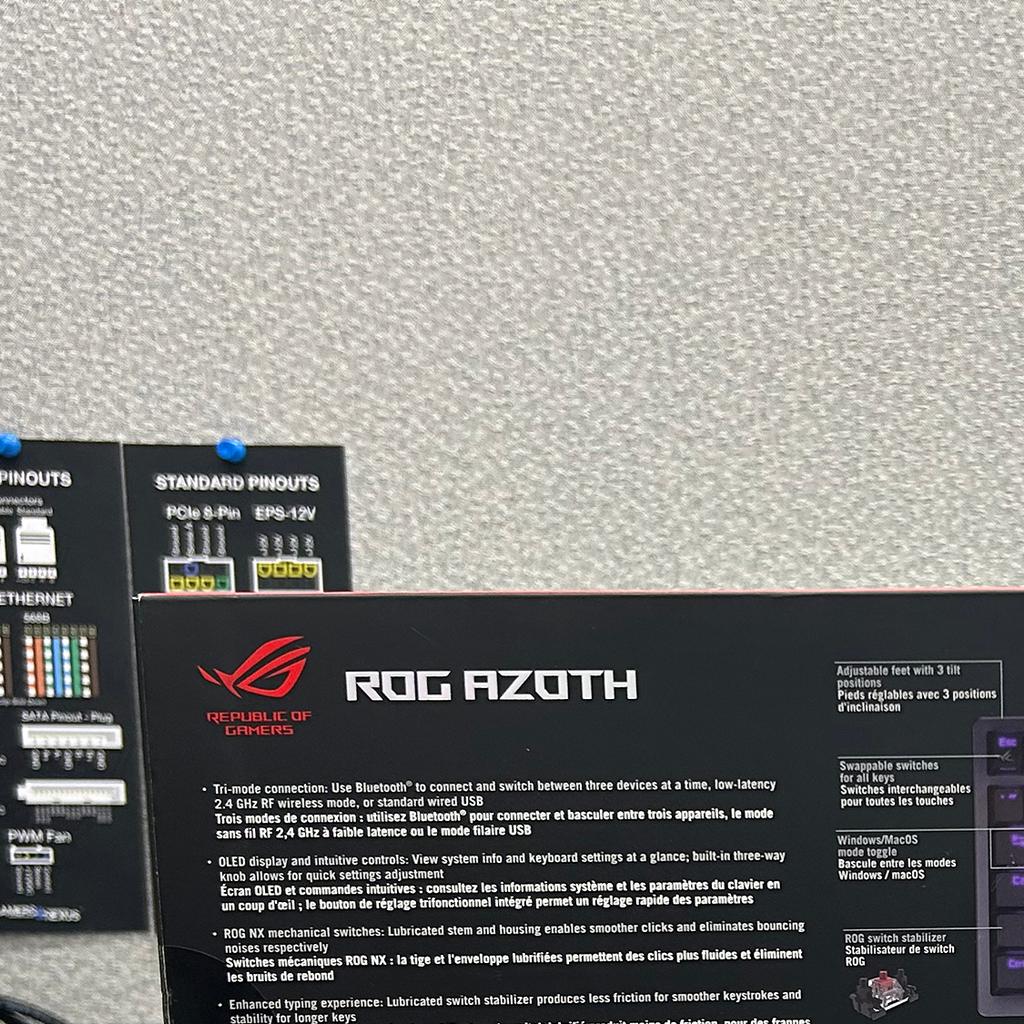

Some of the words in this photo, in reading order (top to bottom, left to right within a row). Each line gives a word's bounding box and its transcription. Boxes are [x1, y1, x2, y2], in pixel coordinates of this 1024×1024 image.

[0, 470, 71, 486] PINOUTS
[155, 474, 244, 490] STANDARD
[247, 475, 319, 491] PINOUTS
[254, 505, 315, 520] EPS-12V
[836, 665, 888, 677] Adjustable
[891, 665, 910, 675] feet
[912, 664, 934, 675] with
[937, 664, 943, 675] 3
[946, 664, 960, 675] tilt
[345, 670, 451, 700] ROG
[463, 669, 637, 700] AZOTH
[837, 677, 881, 689] positions
[837, 689, 865, 700] Pieds
[868, 689, 913, 701] réglables
[916, 690, 939, 699] avec
[942, 688, 949, 699] 3
[952, 688, 997, 700] positions
[838, 701, 900, 712] d'inclinaison
[207, 711, 287, 723] REPUBLIC
[290, 711, 311, 721] OF
[225, 725, 293, 735] GAMERS
[839, 760, 893, 772] Swappable
[895, 760, 939, 770] switches
[839, 772, 853, 782] for
[856, 772, 869, 782] all
[872, 772, 894, 784] keys
[212, 783, 261, 794] Tri-mode
[331, 782, 352, 793] Use
[415, 782, 426, 792] to
[429, 781, 473, 792] connect
[475, 781, 495, 791] and
[499, 780, 534, 791] switch
[537, 780, 582, 790] between
[585, 780, 613, 790] three
[616, 780, 658, 790] devices
[660, 780, 671, 790] at
[674, 781, 681, 790] a
[714, 779, 776, 791] low-latency
[214, 798, 233, 809] 2.4
[236, 798, 258, 809] GHz
[261, 797, 274, 808] RF
[277, 797, 323, 808] wireless
[363, 799, 374, 807] or
[377, 796, 424, 807] standard
[427, 795, 457, 806] wired
[461, 795, 483, 806] USB
[837, 834, 918, 845] Windows/MacOS
[837, 847, 864, 856] mode
[866, 846, 897, 858] toggle
[223, 928, 245, 938] ROG
[249, 927, 264, 938] NX
[267, 927, 330, 938] mechanical
[387, 925, 444, 936] Lubricated
[447, 926, 473, 935] stem
[476, 924, 495, 934] and
[499, 923, 541, 936] housing
[544, 923, 586, 933] enables
[589, 923, 638, 933] smoother
[641, 921, 673, 932] clicks
[676, 921, 696, 932] and
[699, 920, 754, 931] eliminates
[756, 919, 805, 932] bouncing
[845, 933, 864, 943] ROG
[867, 932, 898, 943] switch
[901, 932, 946, 942] stabilizer
[225, 943, 260, 953] noises
[263, 941, 328, 954] respectively
